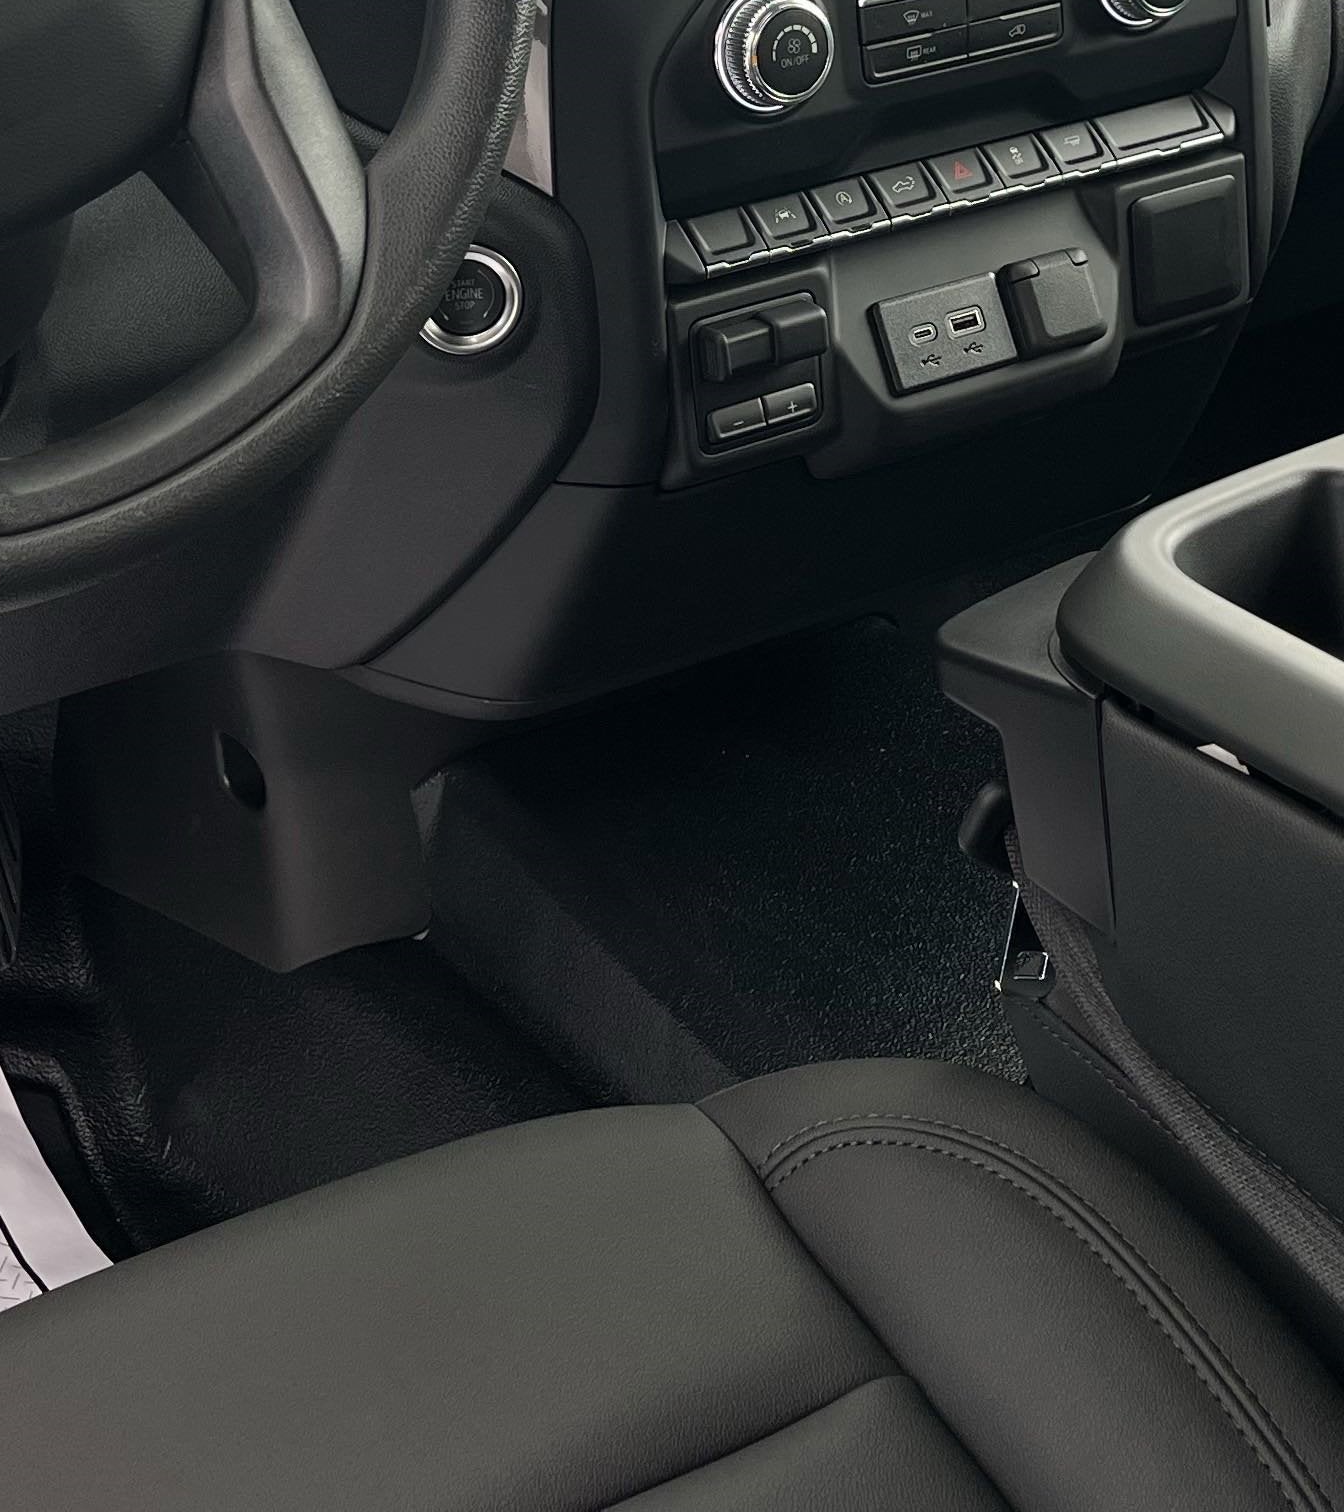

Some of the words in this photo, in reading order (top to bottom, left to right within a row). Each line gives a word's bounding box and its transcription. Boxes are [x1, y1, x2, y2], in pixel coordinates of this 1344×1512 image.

[780, 55, 809, 69] ON/OFF
[445, 288, 484, 301] ENGINE
[455, 300, 476, 311] STOP
